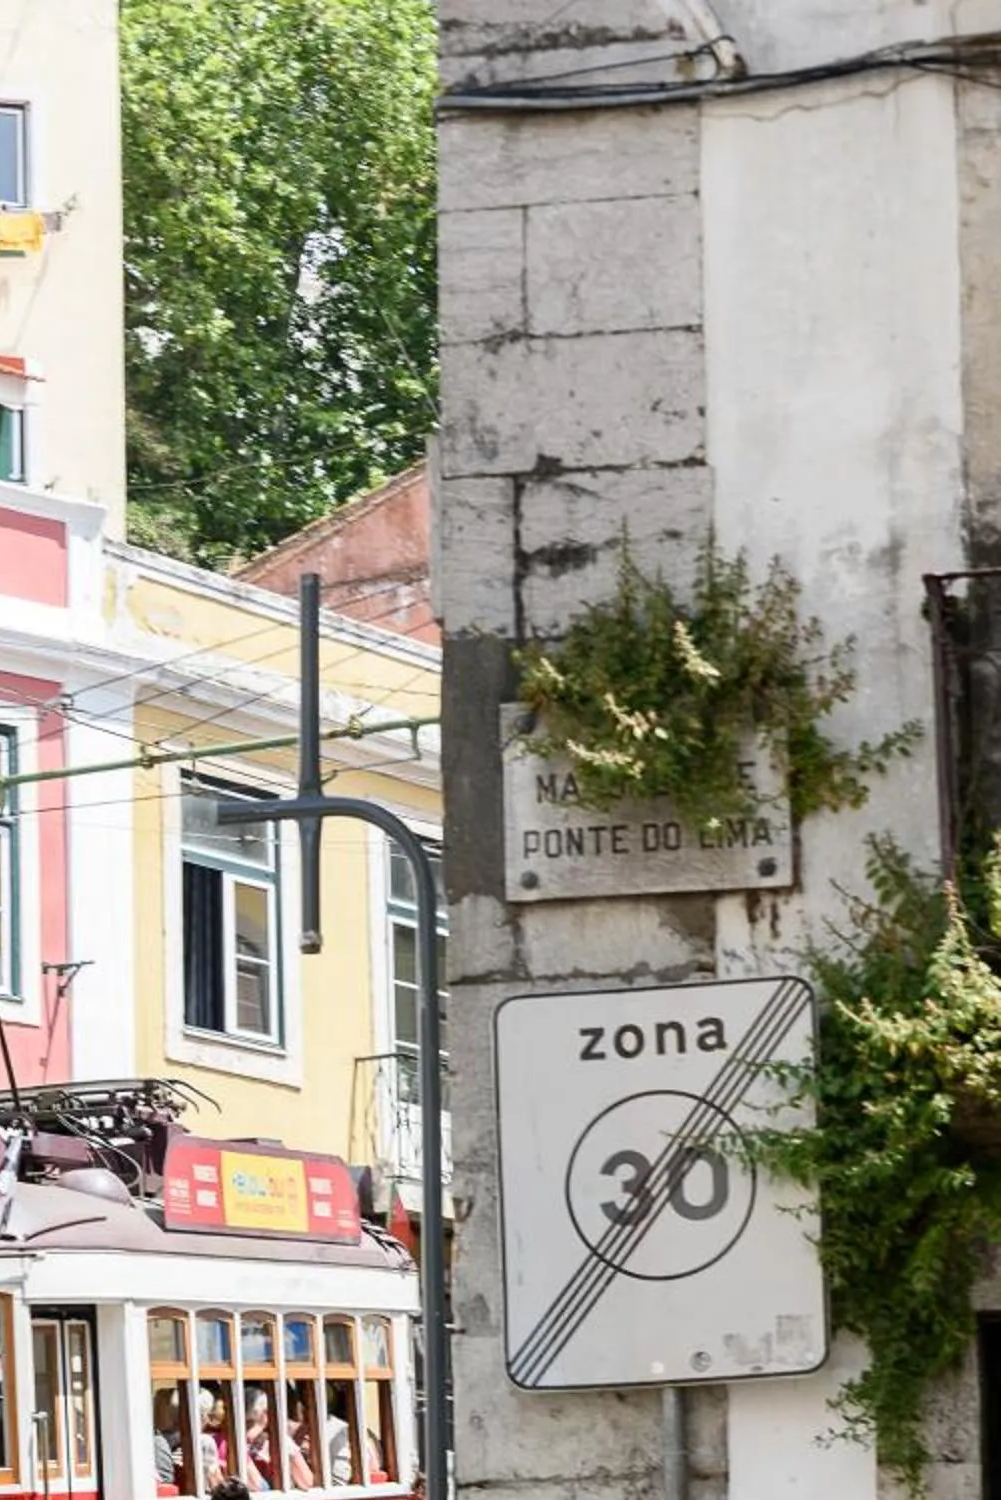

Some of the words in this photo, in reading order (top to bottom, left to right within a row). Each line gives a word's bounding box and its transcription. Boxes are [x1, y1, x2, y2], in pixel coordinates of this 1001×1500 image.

[523, 824, 629, 859] PONTE
[641, 821, 681, 852] DO
[578, 1015, 728, 1061] zona
[599, 1145, 729, 1226] 30
